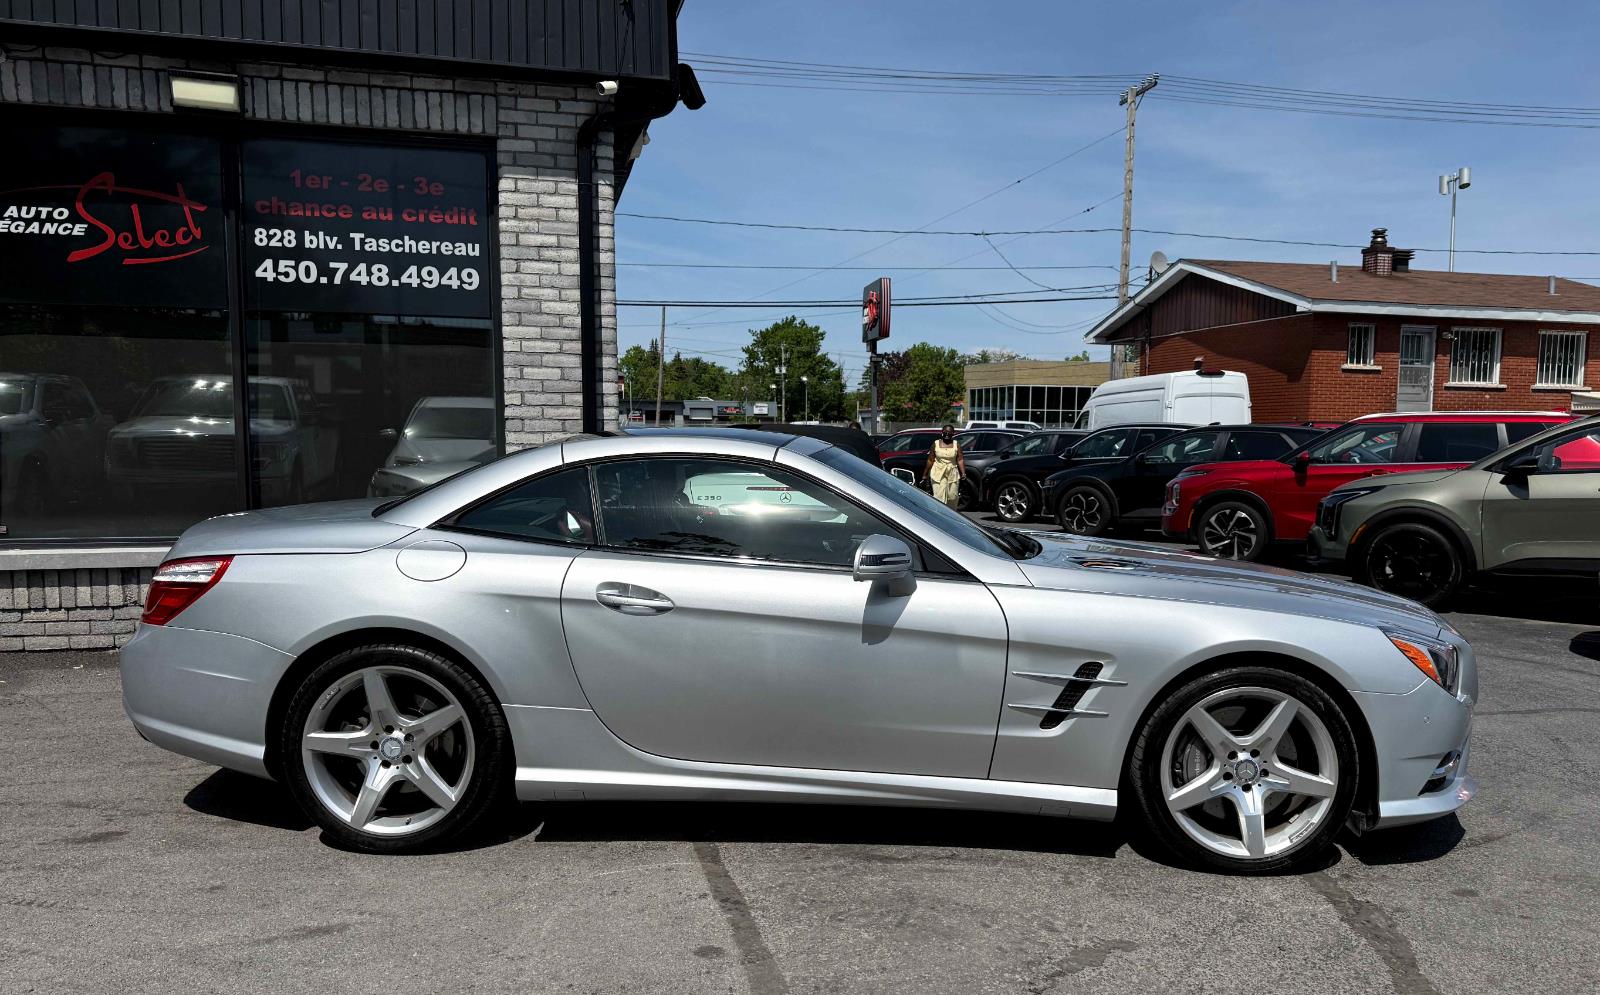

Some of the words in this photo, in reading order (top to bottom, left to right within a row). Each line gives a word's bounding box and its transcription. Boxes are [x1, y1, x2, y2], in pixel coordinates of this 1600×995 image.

[290, 169, 332, 189] 1er
[357, 174, 389, 192] 2e
[414, 177, 444, 195] 3e
[3, 206, 69, 220] AUTO
[67, 171, 208, 263] Select
[255, 197, 352, 218] chance
[362, 206, 393, 221] au
[402, 206, 478, 225] crédit
[254, 228, 296, 248] 828
[304, 231, 342, 249] blv.
[350, 233, 480, 256] Taschereau
[255, 259, 480, 291] 450.748.4949
